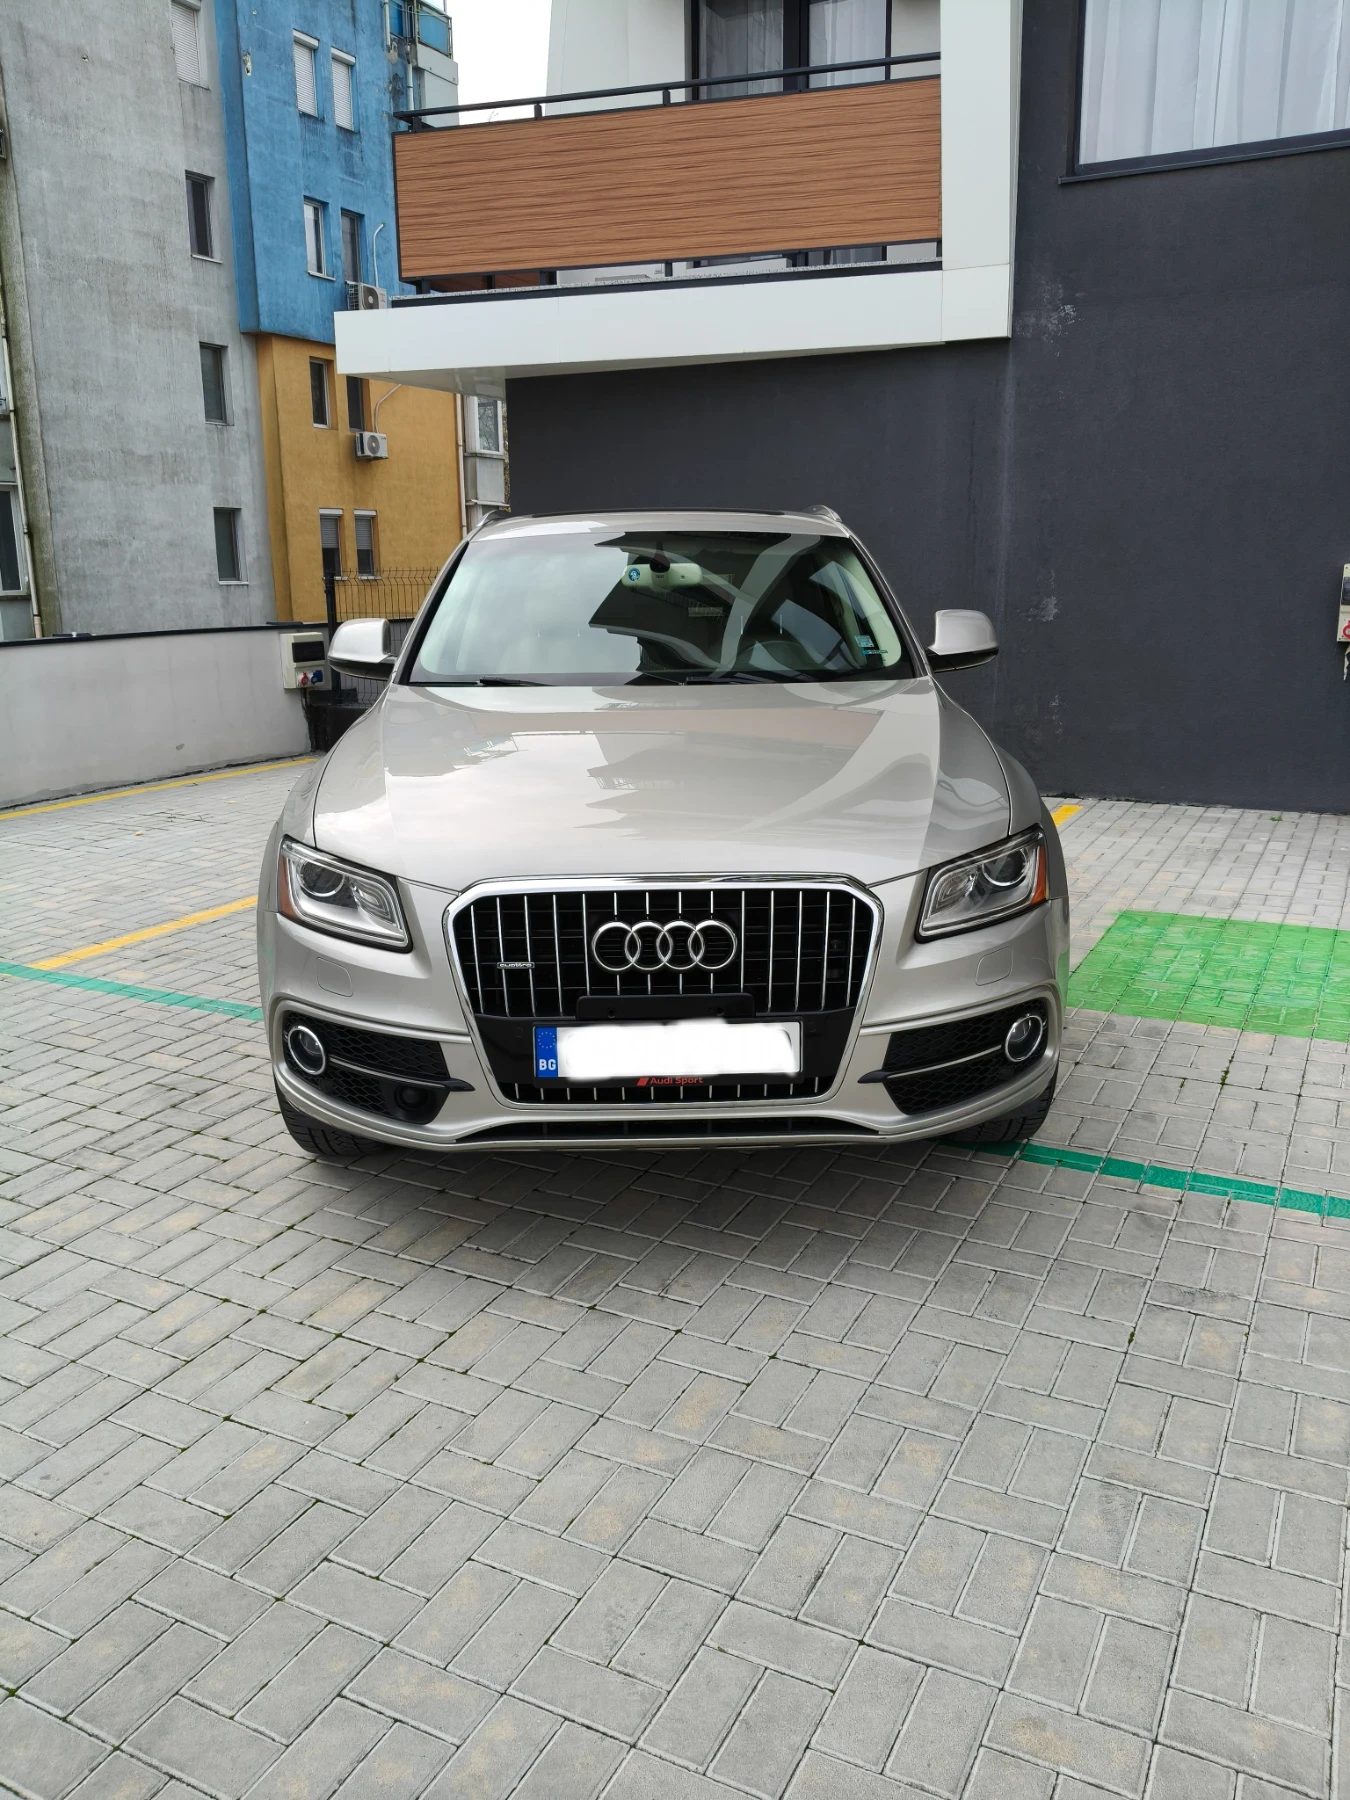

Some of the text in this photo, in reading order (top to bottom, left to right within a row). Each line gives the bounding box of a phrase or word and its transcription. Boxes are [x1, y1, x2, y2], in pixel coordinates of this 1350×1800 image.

[539, 1058, 557, 1071] BG
[650, 1075, 704, 1085] Audi Sport
